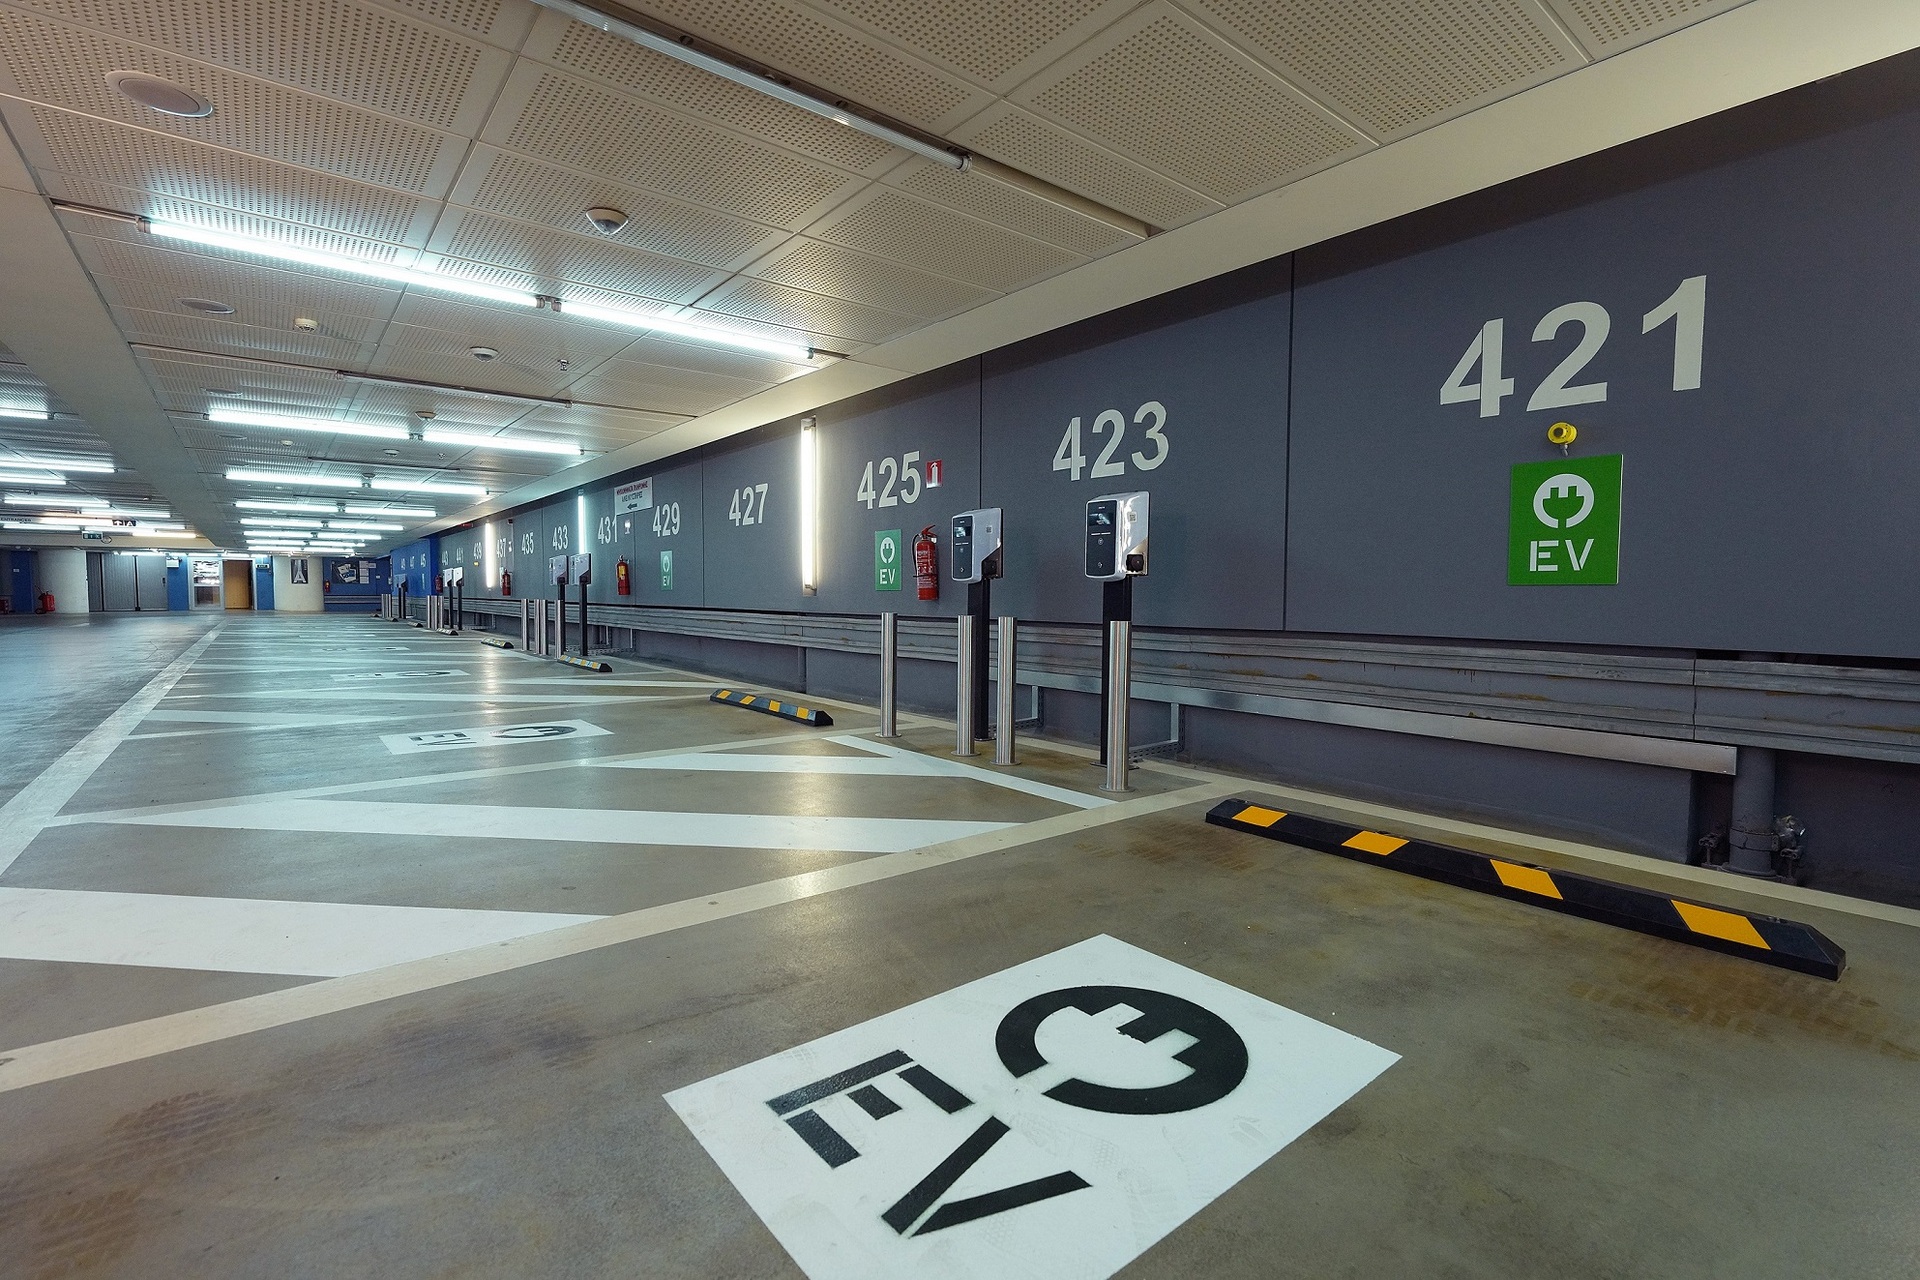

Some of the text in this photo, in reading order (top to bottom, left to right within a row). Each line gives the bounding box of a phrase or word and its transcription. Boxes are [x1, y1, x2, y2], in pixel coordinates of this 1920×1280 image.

[1440, 274, 1707, 418] 421
[1053, 400, 1169, 481] 423
[857, 450, 921, 509] 425
[652, 501, 681, 538] 429
[728, 483, 769, 527] 427
[521, 532, 534, 555] 435
[552, 524, 569, 550] 433
[597, 515, 618, 545] 431
[1529, 538, 1594, 572] EV
[879, 568, 896, 585] EV
[765, 1049, 1093, 1239] EV
